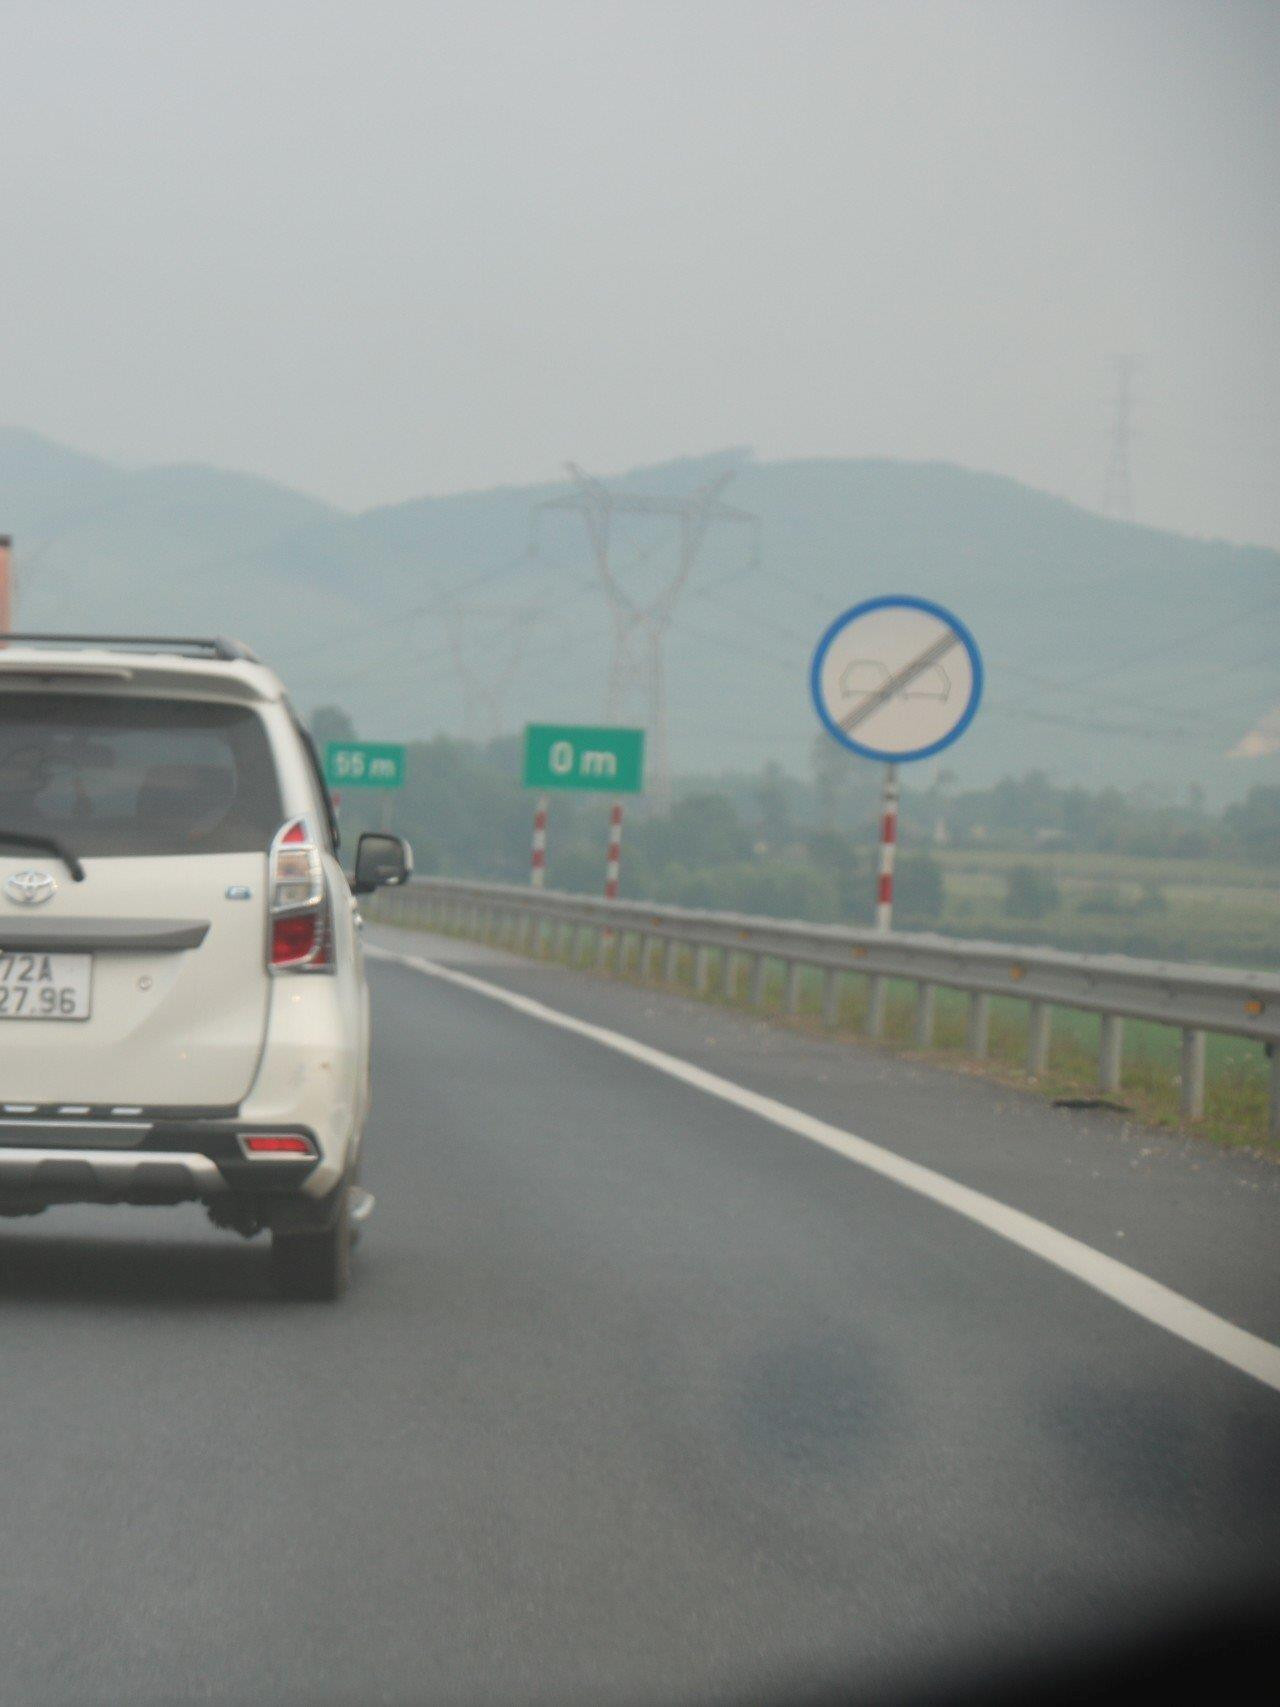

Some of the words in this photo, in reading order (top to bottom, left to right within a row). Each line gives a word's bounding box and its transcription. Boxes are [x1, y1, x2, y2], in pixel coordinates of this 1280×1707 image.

[369, 758, 397, 777] m
[548, 741, 574, 775] 0
[578, 750, 617, 777] m
